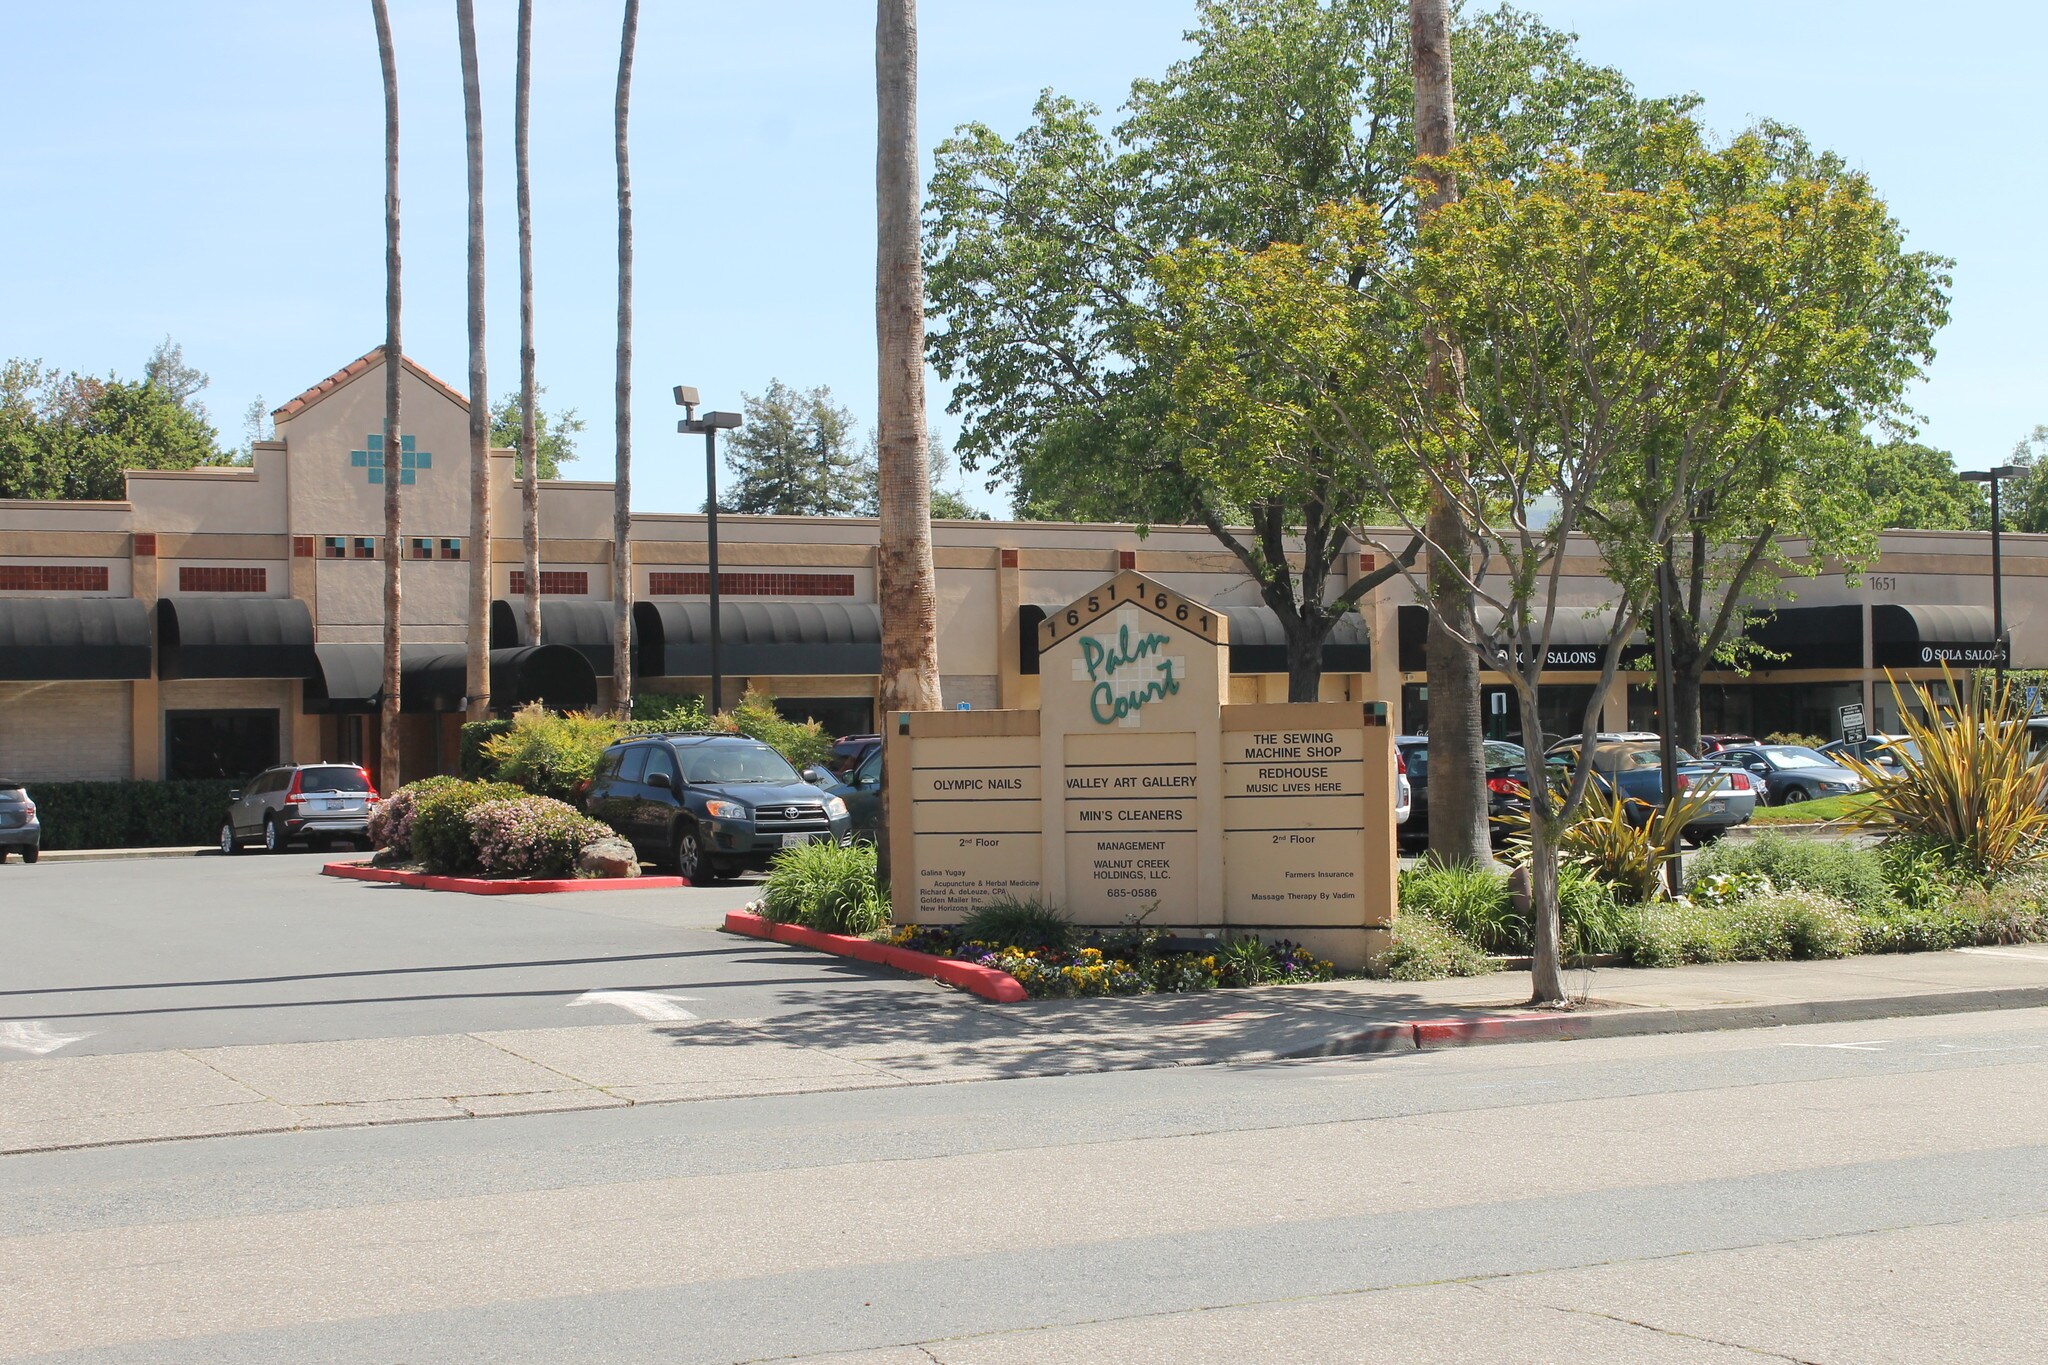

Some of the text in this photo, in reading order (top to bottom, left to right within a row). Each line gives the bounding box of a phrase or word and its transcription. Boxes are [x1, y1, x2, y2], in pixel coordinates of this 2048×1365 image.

[1869, 576, 1896, 591] 1651
[1047, 582, 1209, 638] 1651 1661
[1078, 623, 1170, 682] Palm
[1547, 651, 1597, 664] SALONS
[1934, 649, 1962, 660] SOLA
[1090, 658, 1180, 725] Court
[1253, 732, 1334, 745] THE SEWING
[1245, 746, 1342, 758] MACHINE SHOP
[1258, 767, 1329, 779] REDHOUSE
[933, 779, 1022, 790] OLYMPIC NAILS
[1066, 776, 1197, 788] VALLEY ART GALLERY
[1246, 782, 1342, 793] MUSIC LIVES HERE
[1079, 809, 1183, 821] MIN'S CLEANERS
[959, 838, 999, 847] 2nd Floor
[1272, 834, 1315, 844] 2nd Floor
[1097, 841, 1166, 850] MANAGEMENT
[1093, 859, 1170, 868] WALNUT CREEK
[944, 869, 966, 877] Yugay
[1093, 870, 1171, 880] HOLDINGS, LLC.
[958, 888, 990, 896] deLeuze,
[1106, 888, 1158, 898] 685-0586
[1251, 893, 1285, 901] Massage
[1287, 892, 1317, 900] Therapy
[1319, 892, 1330, 900] By
[920, 896, 946, 904] Golden
